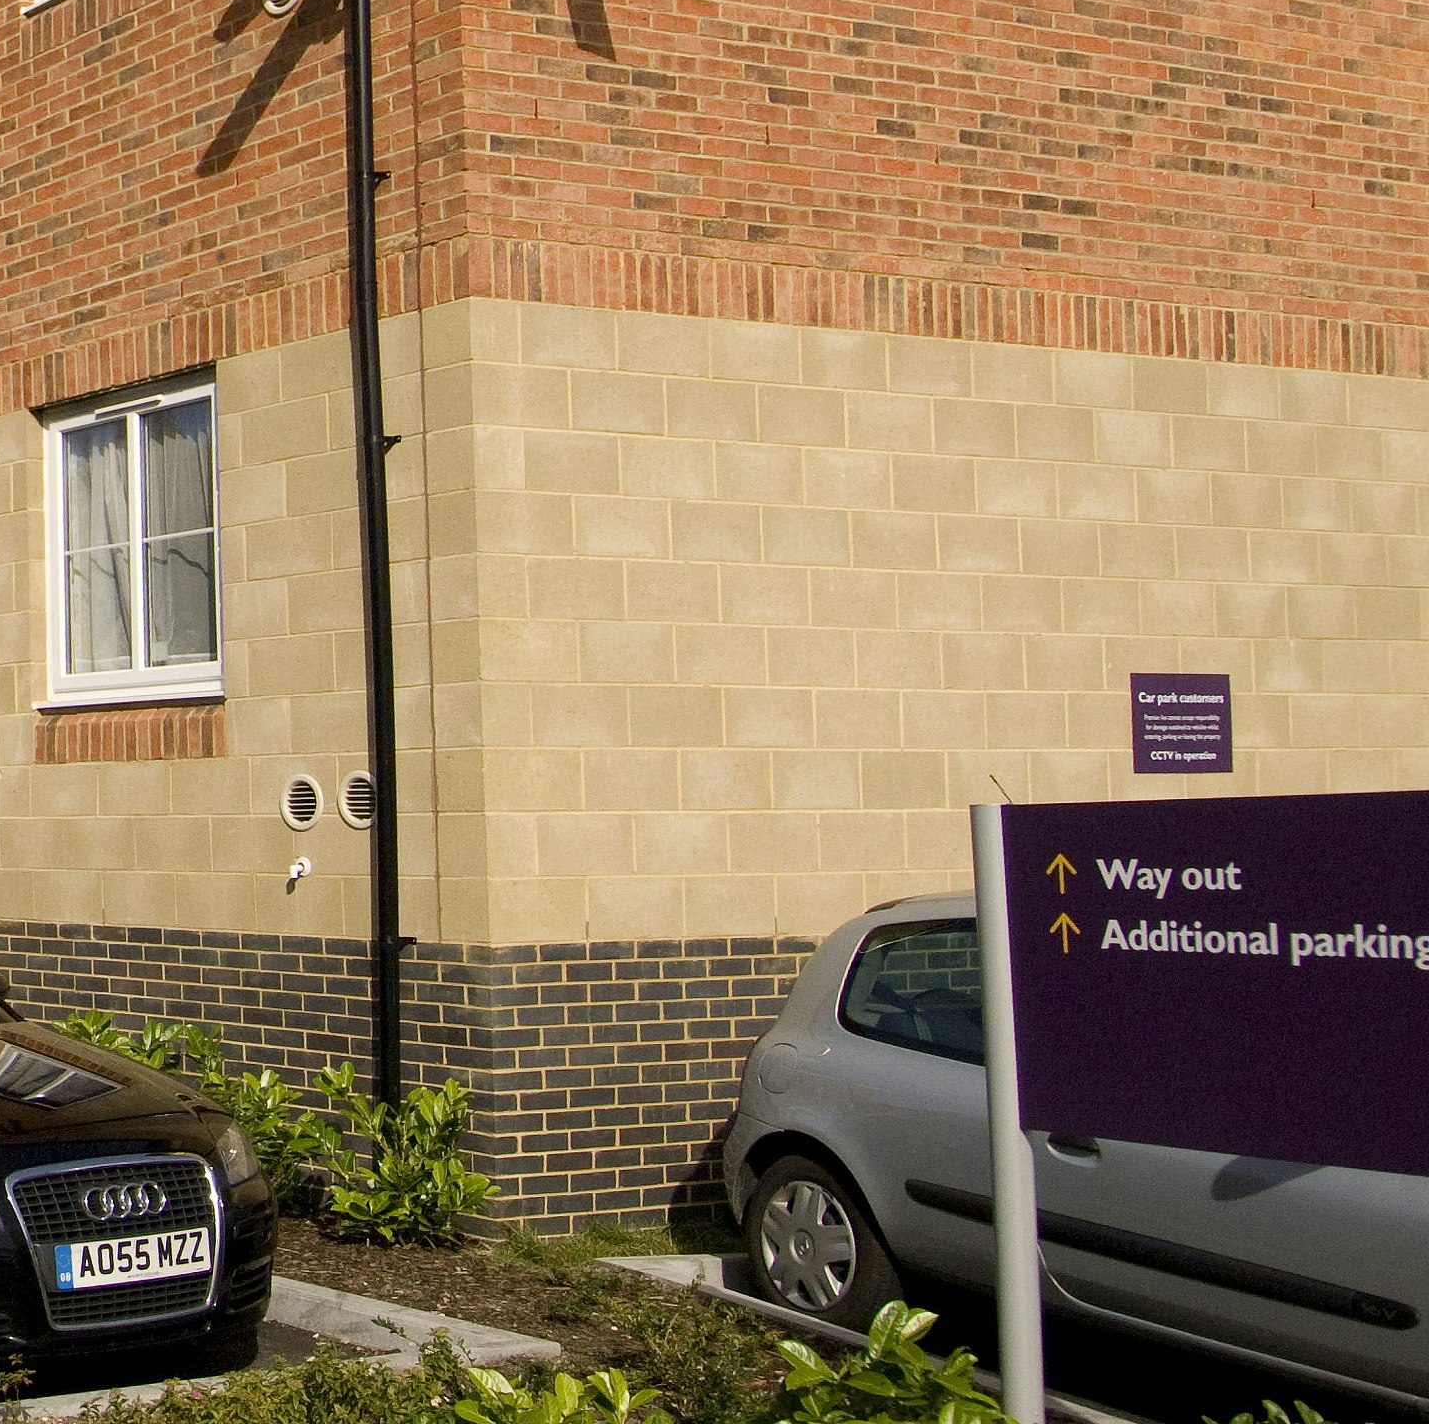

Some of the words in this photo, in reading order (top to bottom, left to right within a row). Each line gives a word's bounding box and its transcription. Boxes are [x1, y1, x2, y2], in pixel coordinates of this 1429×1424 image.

[1138, 691, 1155, 703] Car
[1157, 692, 1178, 706] park
[1179, 693, 1224, 704] customers
[1150, 750, 1174, 761] CCTV
[1174, 751, 1182, 760] in
[1182, 750, 1217, 762] operation
[1095, 858, 1173, 899] Way
[1181, 862, 1242, 891] out
[1100, 919, 1279, 956] Additional
[1290, 923, 1429, 970] parking
[79, 1238, 151, 1278] AO55
[157, 1230, 205, 1268] MZZ
